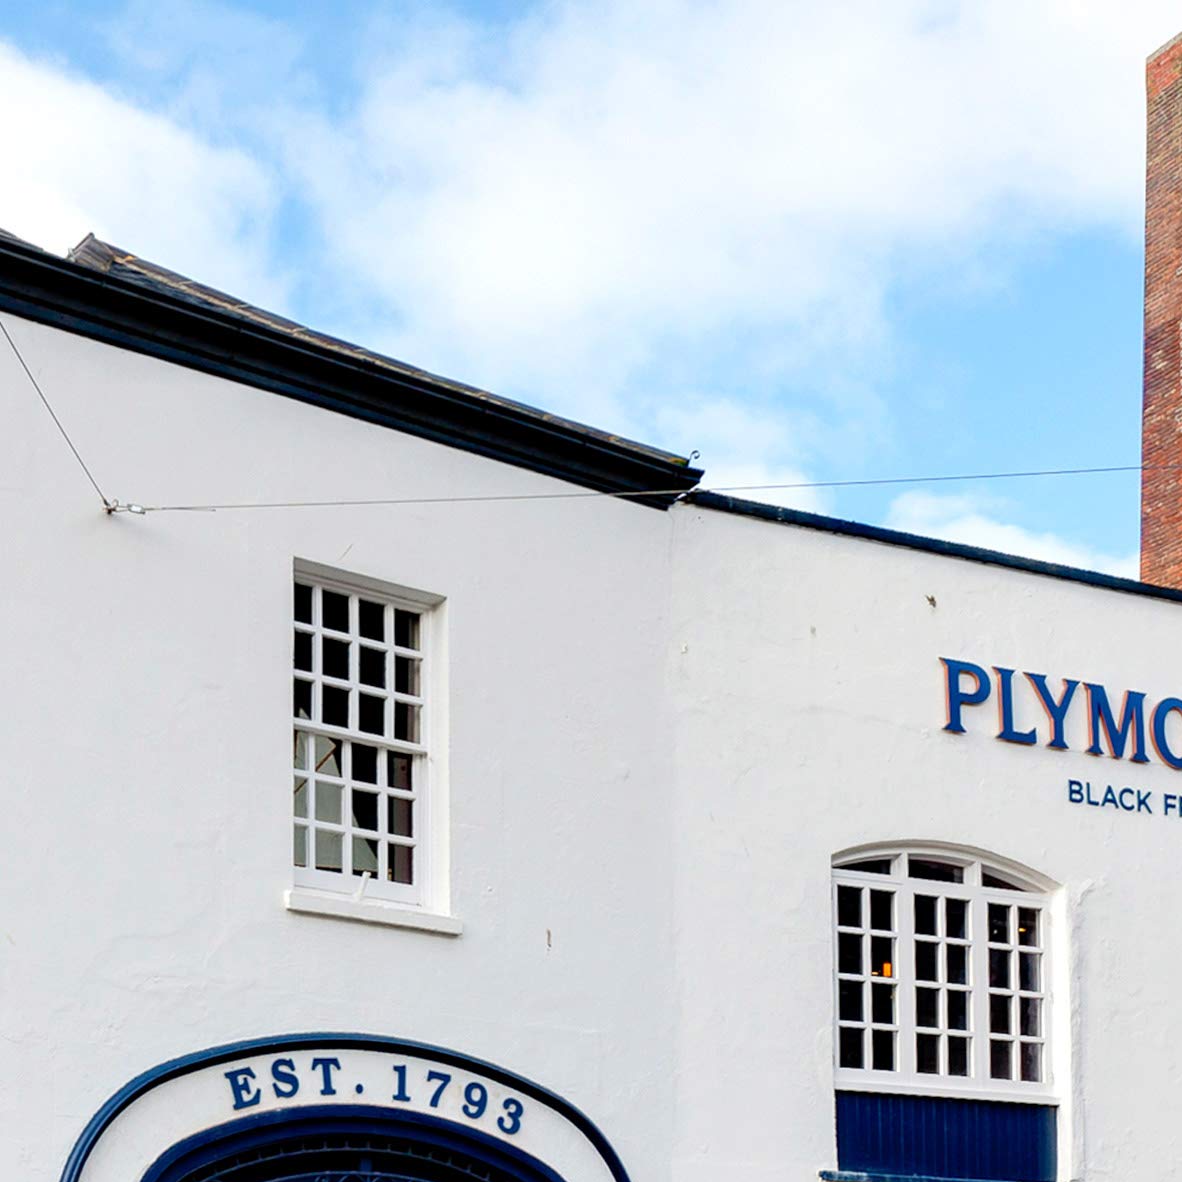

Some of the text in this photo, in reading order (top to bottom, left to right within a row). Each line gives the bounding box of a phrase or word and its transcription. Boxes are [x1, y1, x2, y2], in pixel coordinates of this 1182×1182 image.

[1067, 780, 1152, 815] BLACK
[224, 1057, 525, 1135] EST. 1793
